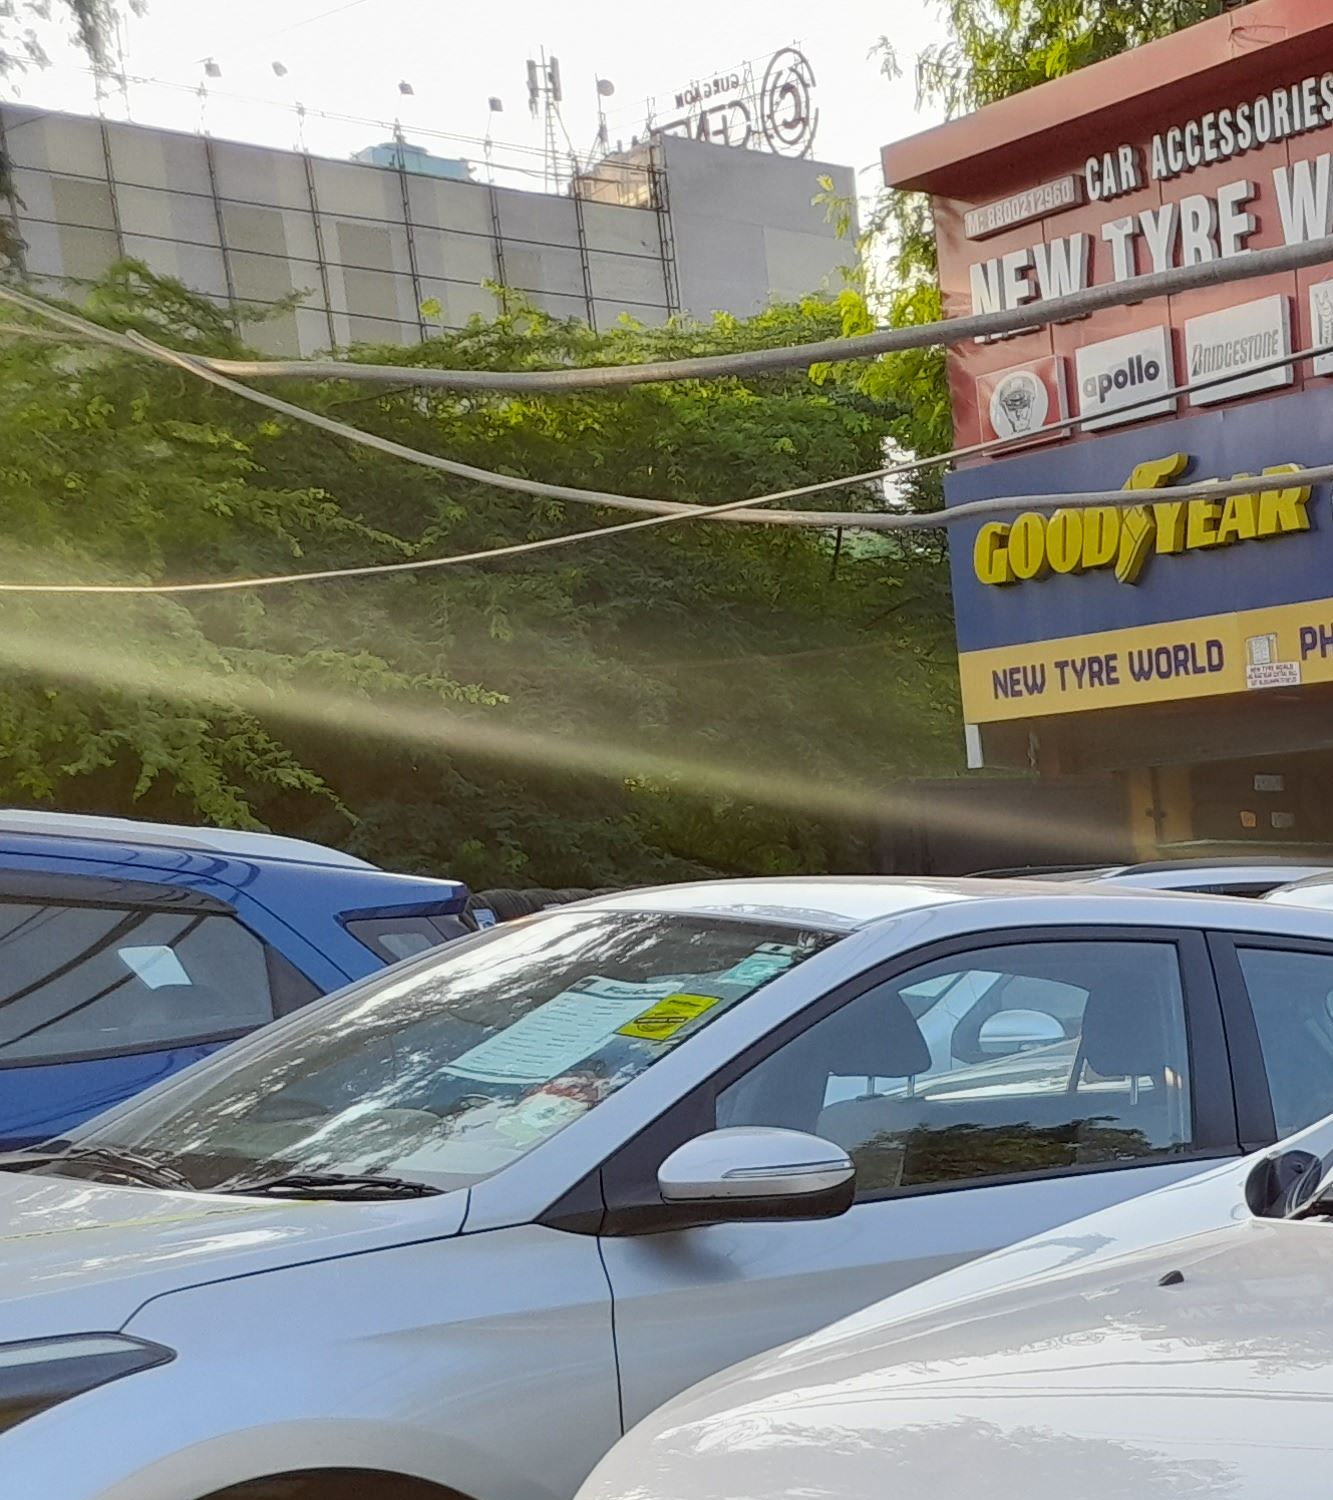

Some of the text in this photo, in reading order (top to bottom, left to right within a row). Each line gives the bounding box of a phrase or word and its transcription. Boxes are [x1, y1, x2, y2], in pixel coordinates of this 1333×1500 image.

[1085, 144, 1138, 201] CAR
[969, 232, 1086, 343] NEW
[1102, 180, 1256, 286] TYRE
[1083, 354, 1160, 403] apollo
[1191, 329, 1279, 377] BRIDGESTONE
[974, 454, 1312, 585] GOODYEAR
[992, 663, 1046, 700] NEW
[1054, 653, 1121, 692] TYRE
[1127, 639, 1224, 683] WORLD
